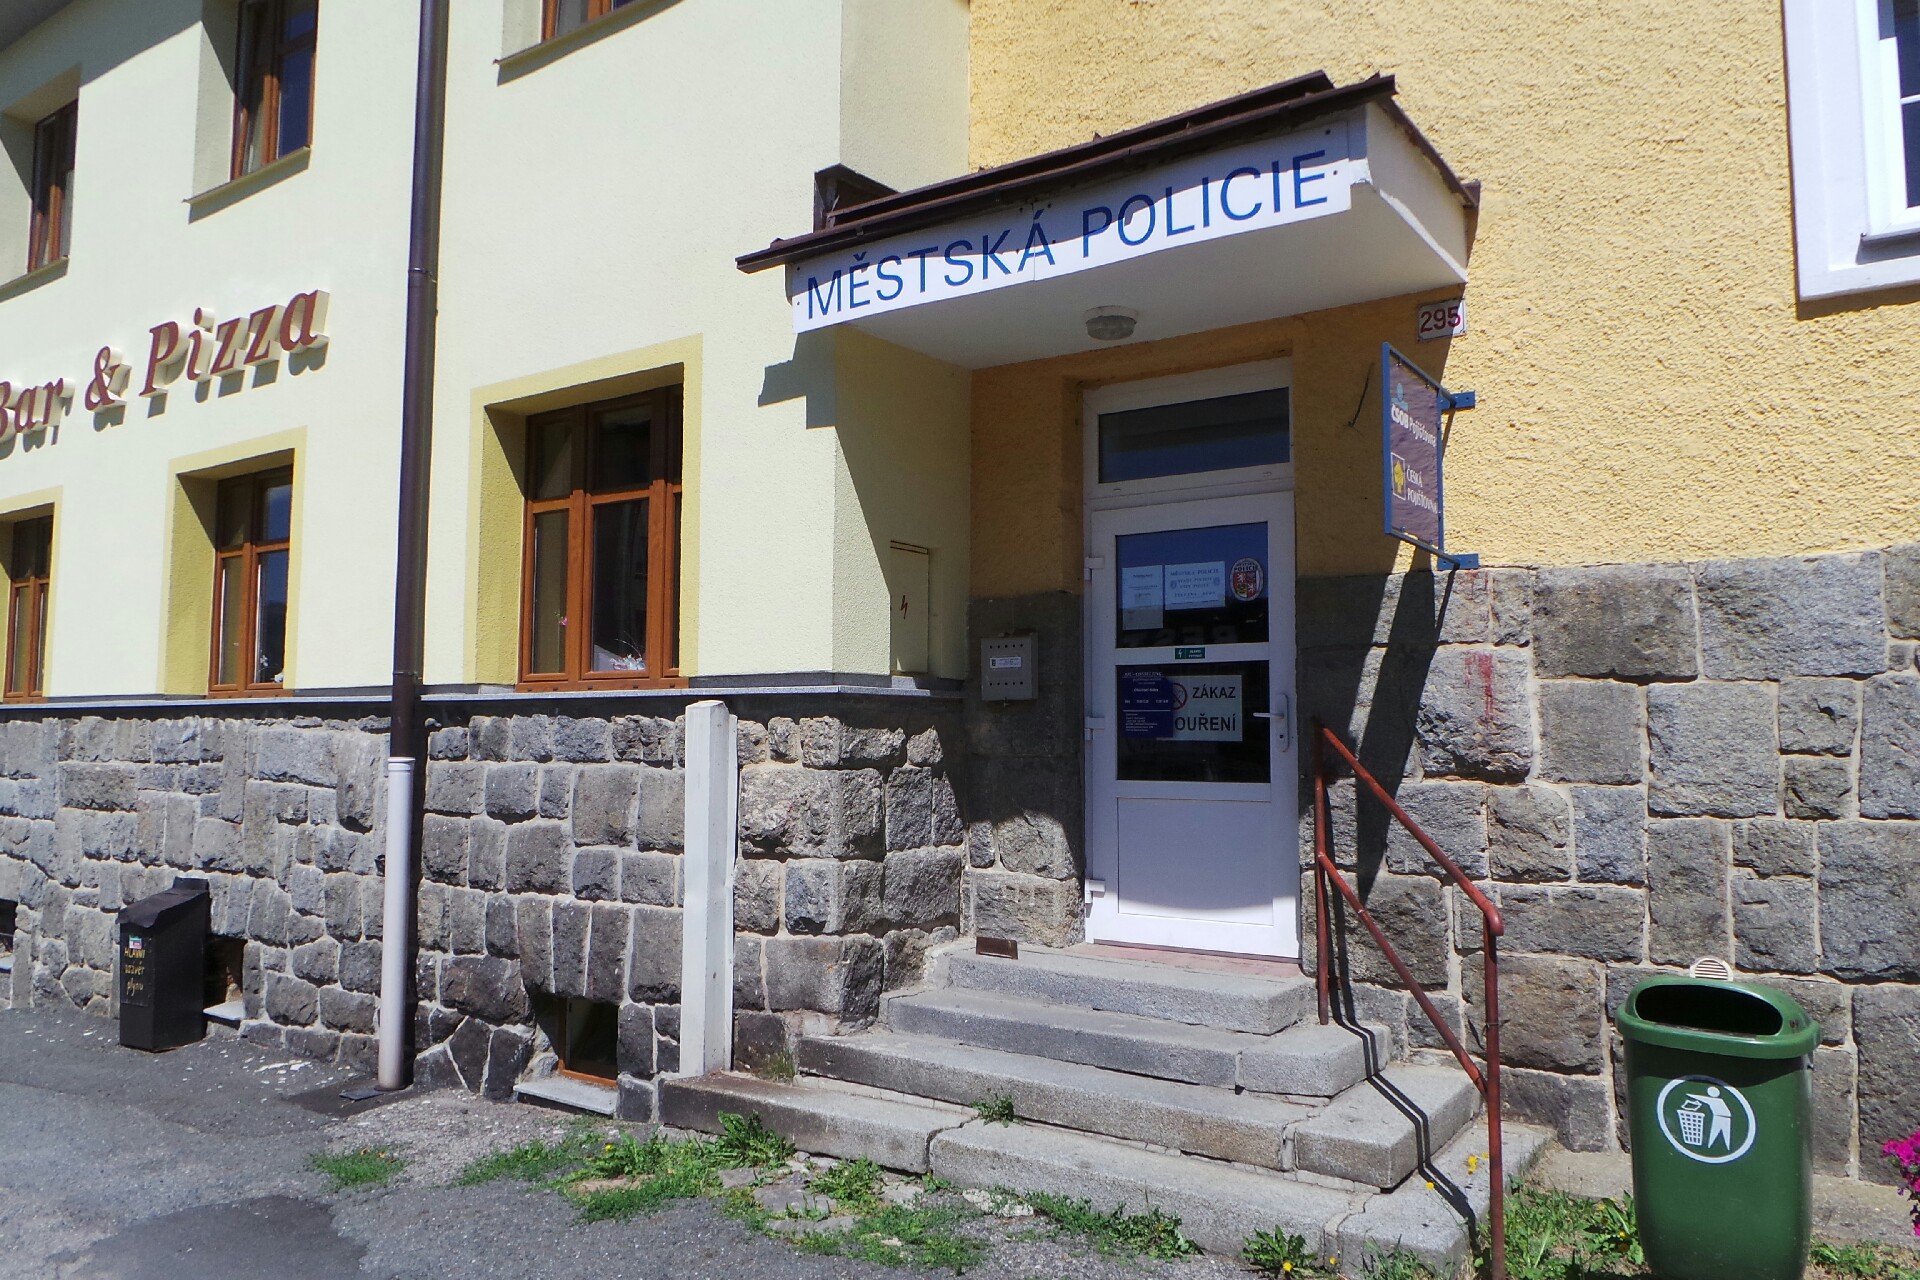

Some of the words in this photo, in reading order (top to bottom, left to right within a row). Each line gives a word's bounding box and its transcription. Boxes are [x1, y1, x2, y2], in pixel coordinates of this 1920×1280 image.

[806, 210, 1055, 320] MĚSTSKÁ
[1081, 149, 1328, 259] POLICIE
[1420, 305, 1461, 333] 295
[85, 346, 121, 411] &
[139, 289, 320, 397] Pizza
[1406, 465, 1423, 488] ČESKÁ
[1192, 684, 1236, 699] ZÁKAZ
[1174, 713, 1236, 732] OUŘENÍ
